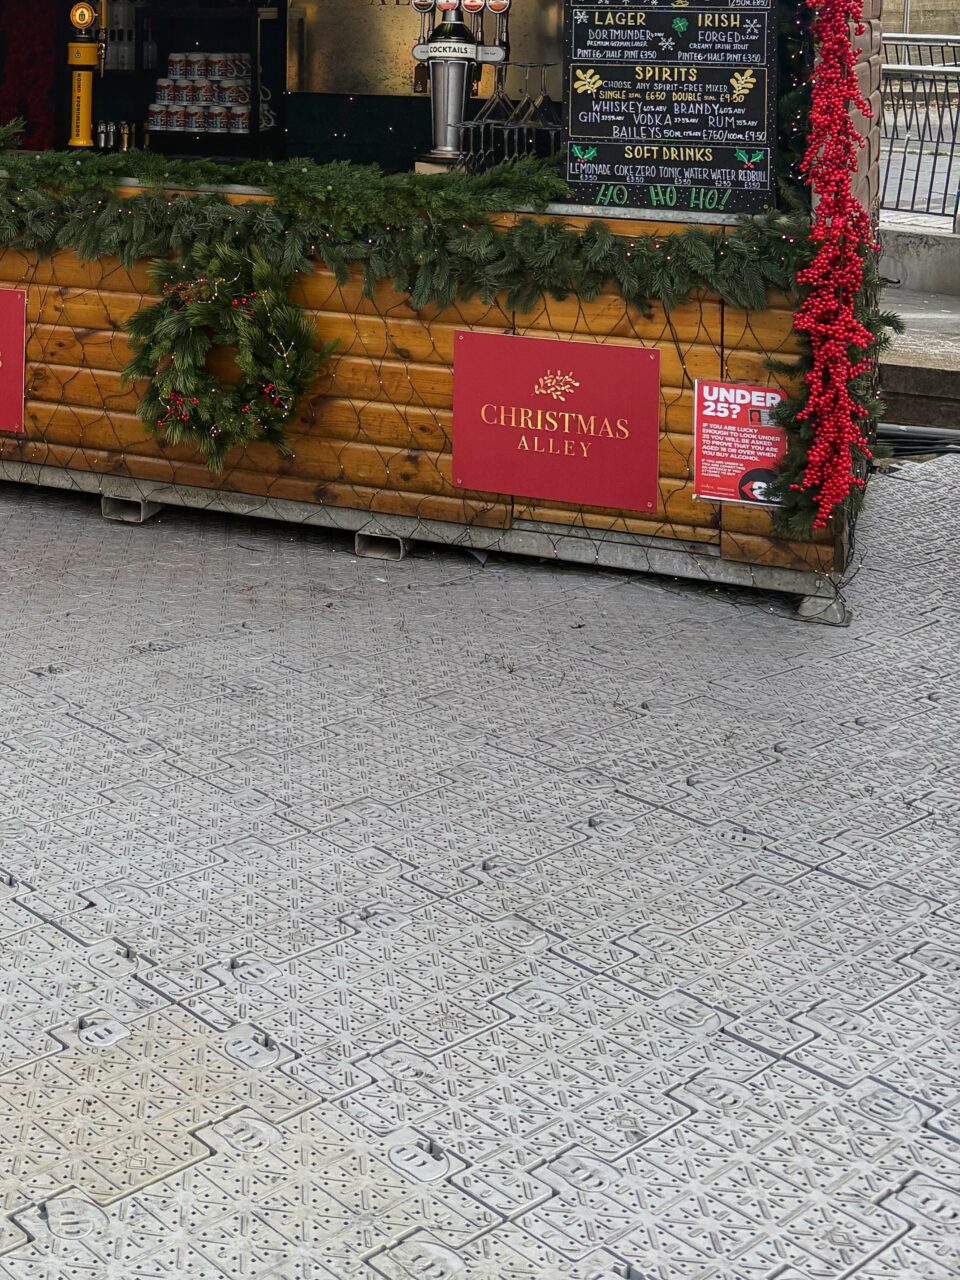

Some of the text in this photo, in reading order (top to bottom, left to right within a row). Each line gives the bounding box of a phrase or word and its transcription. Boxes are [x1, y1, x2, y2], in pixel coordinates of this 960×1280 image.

[594, 11, 646, 26] LAGER
[698, 13, 741, 28] IRISH
[588, 28, 652, 41] DORTMUNDER
[698, 30, 741, 42] FORGED
[429, 46, 468, 54] COCKTAILS
[577, 48, 639, 58] PINT PINT
[677, 51, 742, 61] PINT PINT
[635, 66, 698, 81] SPIRITS
[602, 80, 728, 93] CHOOSE ANY SPIRIT-FREE MIXER
[599, 90, 702, 102] SINGLE DOUBLE
[591, 100, 720, 115] WHISKEY BRANDY
[578, 111, 735, 128] GIN VODKA RUM
[612, 125, 662, 138] BAILEYS
[624, 145, 713, 161] SOFT DRINKS
[570, 162, 767, 182] LEMONADE COKE ZERO TONIC WATER WATER REDBULL
[595, 183, 732, 210] HO HO HO!
[703, 385, 781, 407] UNDER
[702, 401, 741, 419] 25?
[480, 403, 630, 440] CHRISTMAS
[702, 428, 729, 436] ENOUGH
[516, 435, 592, 458] ALLEY
